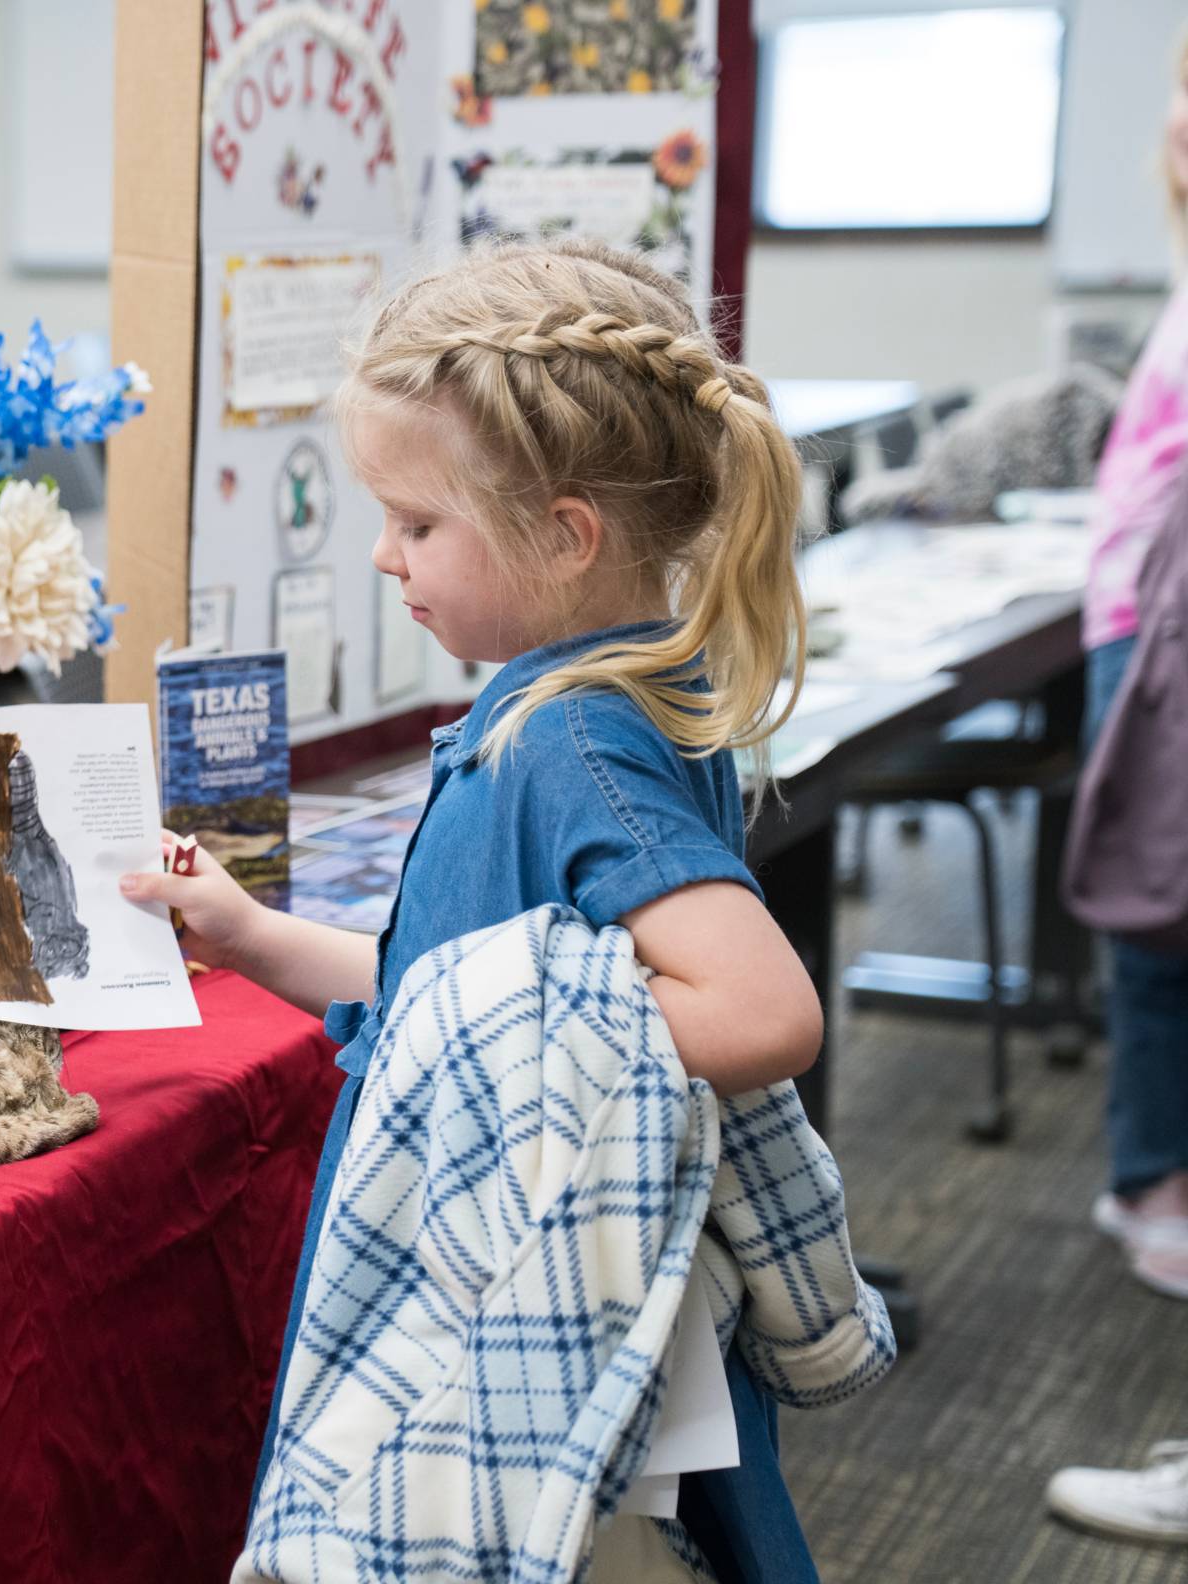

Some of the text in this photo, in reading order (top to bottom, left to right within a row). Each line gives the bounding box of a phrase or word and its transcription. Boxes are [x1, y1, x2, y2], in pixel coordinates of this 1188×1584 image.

[211, 38, 395, 187] SOCIETY
[192, 683, 270, 715] TEXAS
[205, 743, 258, 763] PLANTS
